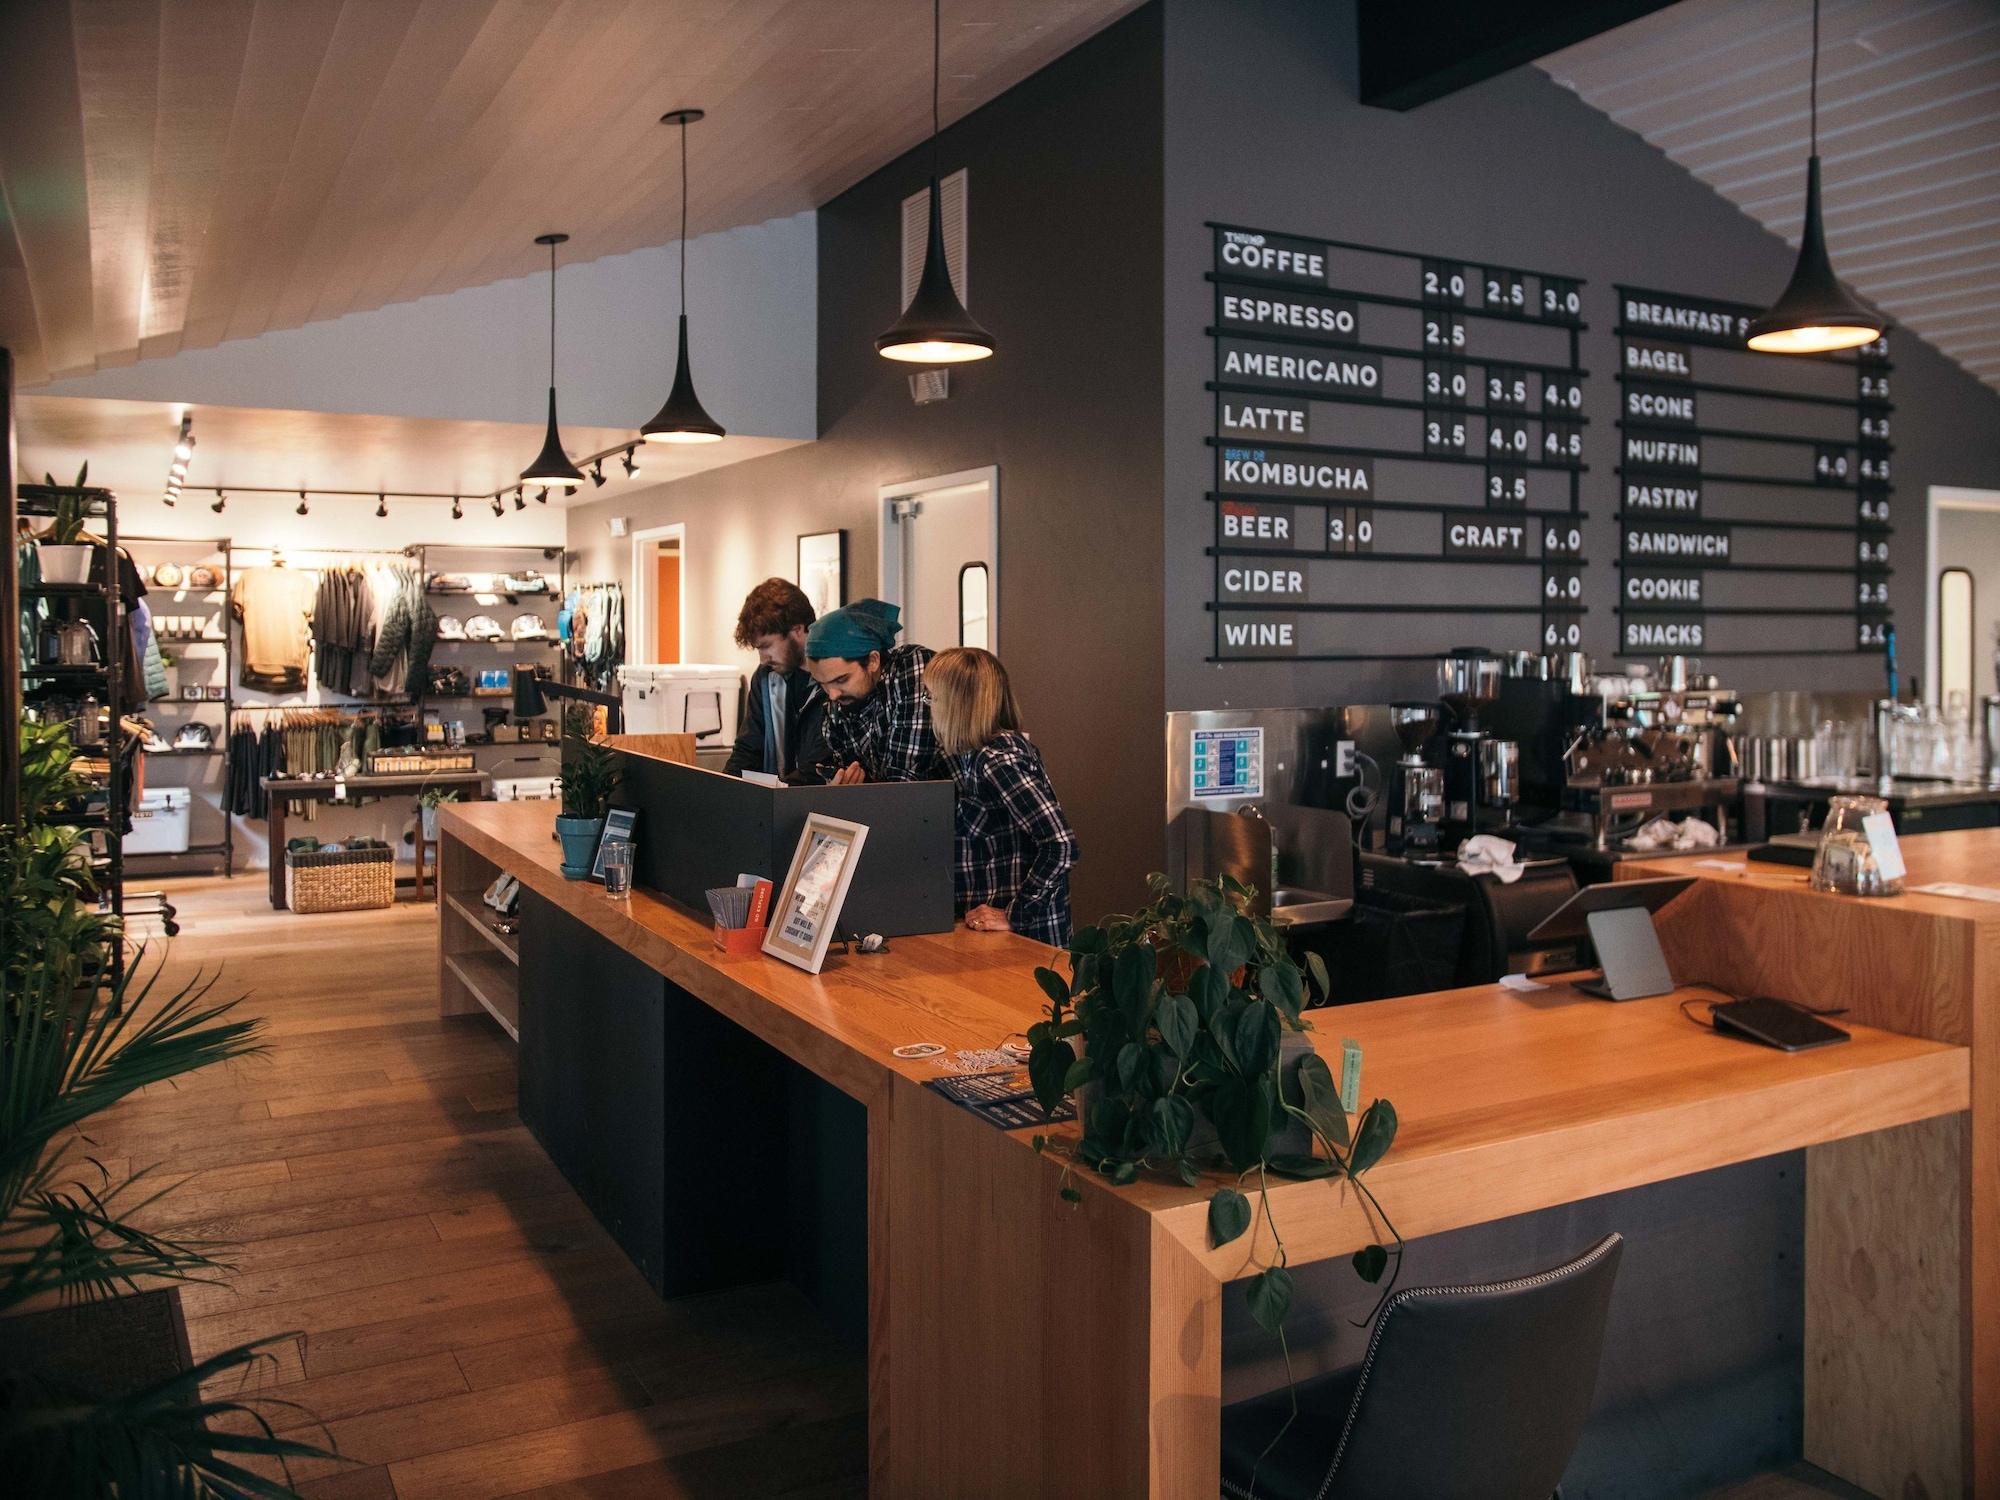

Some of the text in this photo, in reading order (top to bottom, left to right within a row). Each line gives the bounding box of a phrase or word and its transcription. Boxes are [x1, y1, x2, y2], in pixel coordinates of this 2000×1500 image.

[1222, 243, 1579, 312] COFFEE 2.0 2.5 3.0
[1224, 297, 1465, 346] ESPRESSO 2.5
[1627, 301, 1732, 335] BREAKFAST
[1225, 351, 1581, 407] AMERICANO 3.0 3.5 4.0
[1628, 347, 1888, 396] BAGEL 2.5
[1225, 405, 1580, 454] LATTE 3.5 4.0 4.5
[1629, 393, 1889, 436] SCONE 4.3
[1628, 440, 1889, 478] MUFFIN 4.0 4.5
[1224, 461, 1525, 499] KOMBUCHA 3.5
[1628, 486, 1889, 520] PASTRY 4.0
[1225, 515, 1580, 550] BEER 3.0 CRAFT 6.0
[1629, 532, 1728, 555] SANDWICH
[1225, 570, 1580, 597] CIDER 6.0
[1628, 579, 1888, 602] COOKIE 2.5
[1225, 624, 1580, 645] WINE 6.0
[1628, 625, 1702, 645] SNACKS
